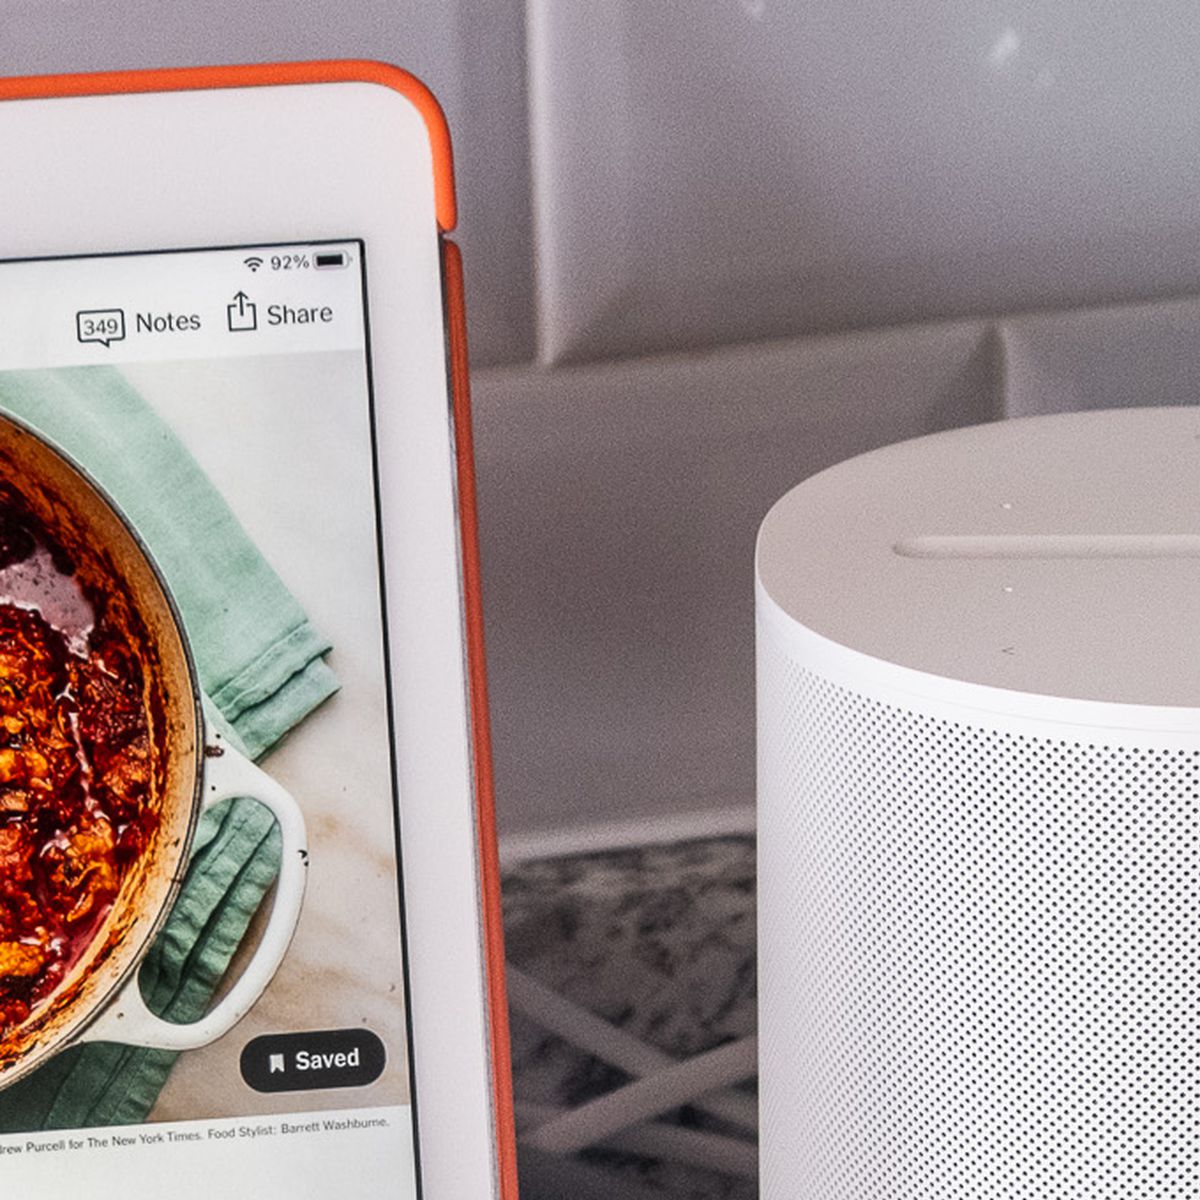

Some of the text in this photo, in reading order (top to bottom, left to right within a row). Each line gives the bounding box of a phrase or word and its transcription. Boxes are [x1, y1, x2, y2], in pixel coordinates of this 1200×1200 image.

[270, 254, 310, 271] 92%
[83, 312, 202, 337] 349 Notes
[267, 304, 333, 326] Share
[295, 1047, 360, 1071] Saved
[25, 1139, 66, 1153] Purcell
[68, 1138, 85, 1150] for
[86, 1137, 109, 1148] The
[111, 1135, 137, 1146] New
[138, 1133, 165, 1145] York
[166, 1130, 203, 1143] Times.
[207, 1127, 236, 1140] Food
[238, 1125, 277, 1139] Stylist:
[280, 1122, 321, 1135] Barrett
